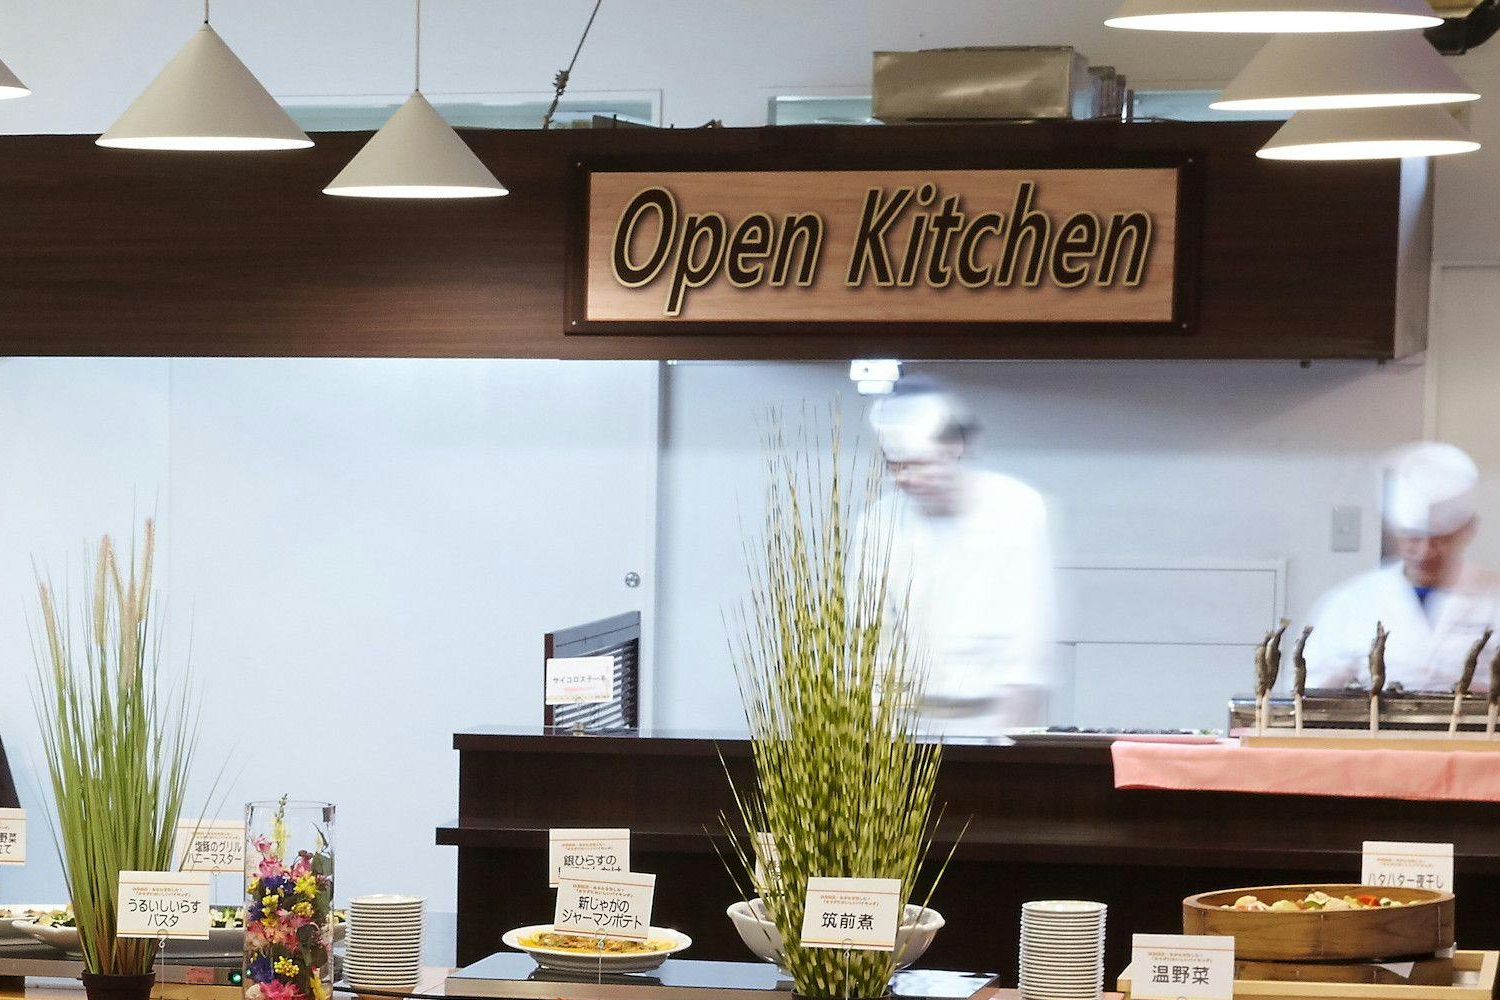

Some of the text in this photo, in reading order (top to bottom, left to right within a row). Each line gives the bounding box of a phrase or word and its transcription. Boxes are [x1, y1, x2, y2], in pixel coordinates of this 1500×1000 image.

[612, 180, 1151, 317] Open Kitchen
[563, 854, 617, 867] 銀ひらすの
[128, 898, 201, 914] うるいしいらす
[578, 895, 630, 914] 新じゃがの
[147, 913, 180, 928] パスタ
[562, 908, 642, 930] ジャーマンポテト
[821, 911, 874, 931] 筑前煮
[1152, 965, 1209, 985] 温野菜
